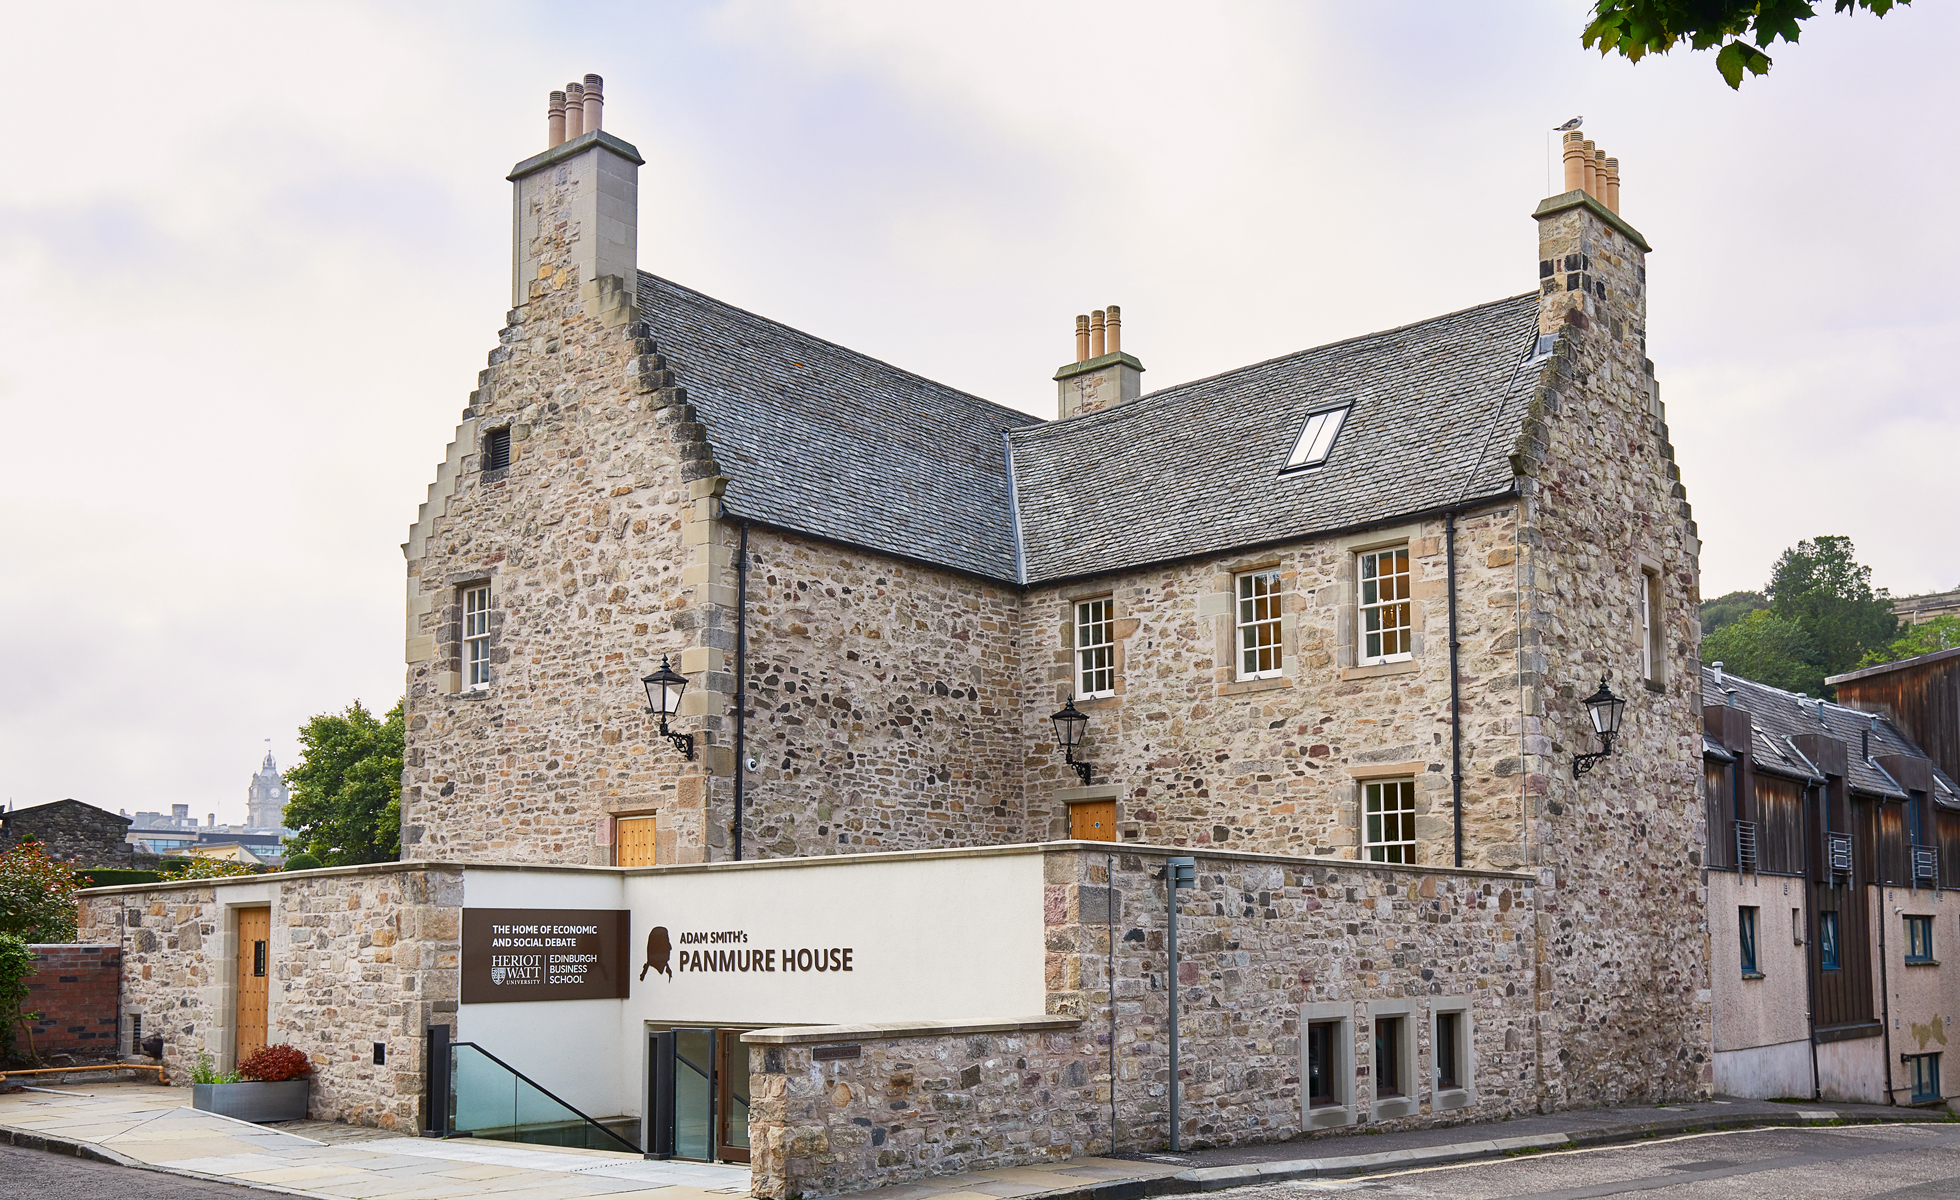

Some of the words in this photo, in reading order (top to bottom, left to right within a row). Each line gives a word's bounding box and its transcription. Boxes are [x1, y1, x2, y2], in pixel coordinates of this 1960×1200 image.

[492, 925, 510, 934] THE
[512, 925, 538, 934] HOME
[540, 925, 552, 934] OF
[553, 925, 597, 934] ECONOMIC
[492, 938, 512, 947] AND
[513, 938, 543, 947] SOCIAL
[545, 938, 577, 947] DEBATE
[680, 932, 708, 944] ADAM
[492, 954, 542, 966] HERIOT
[549, 954, 597, 963] EDINBURGH
[679, 949, 776, 972] PANMURE
[782, 948, 853, 972] HOUSE
[506, 966, 542, 978] WATT
[549, 965, 588, 974] BUSINESS
[549, 975, 584, 984] SCHOOL
